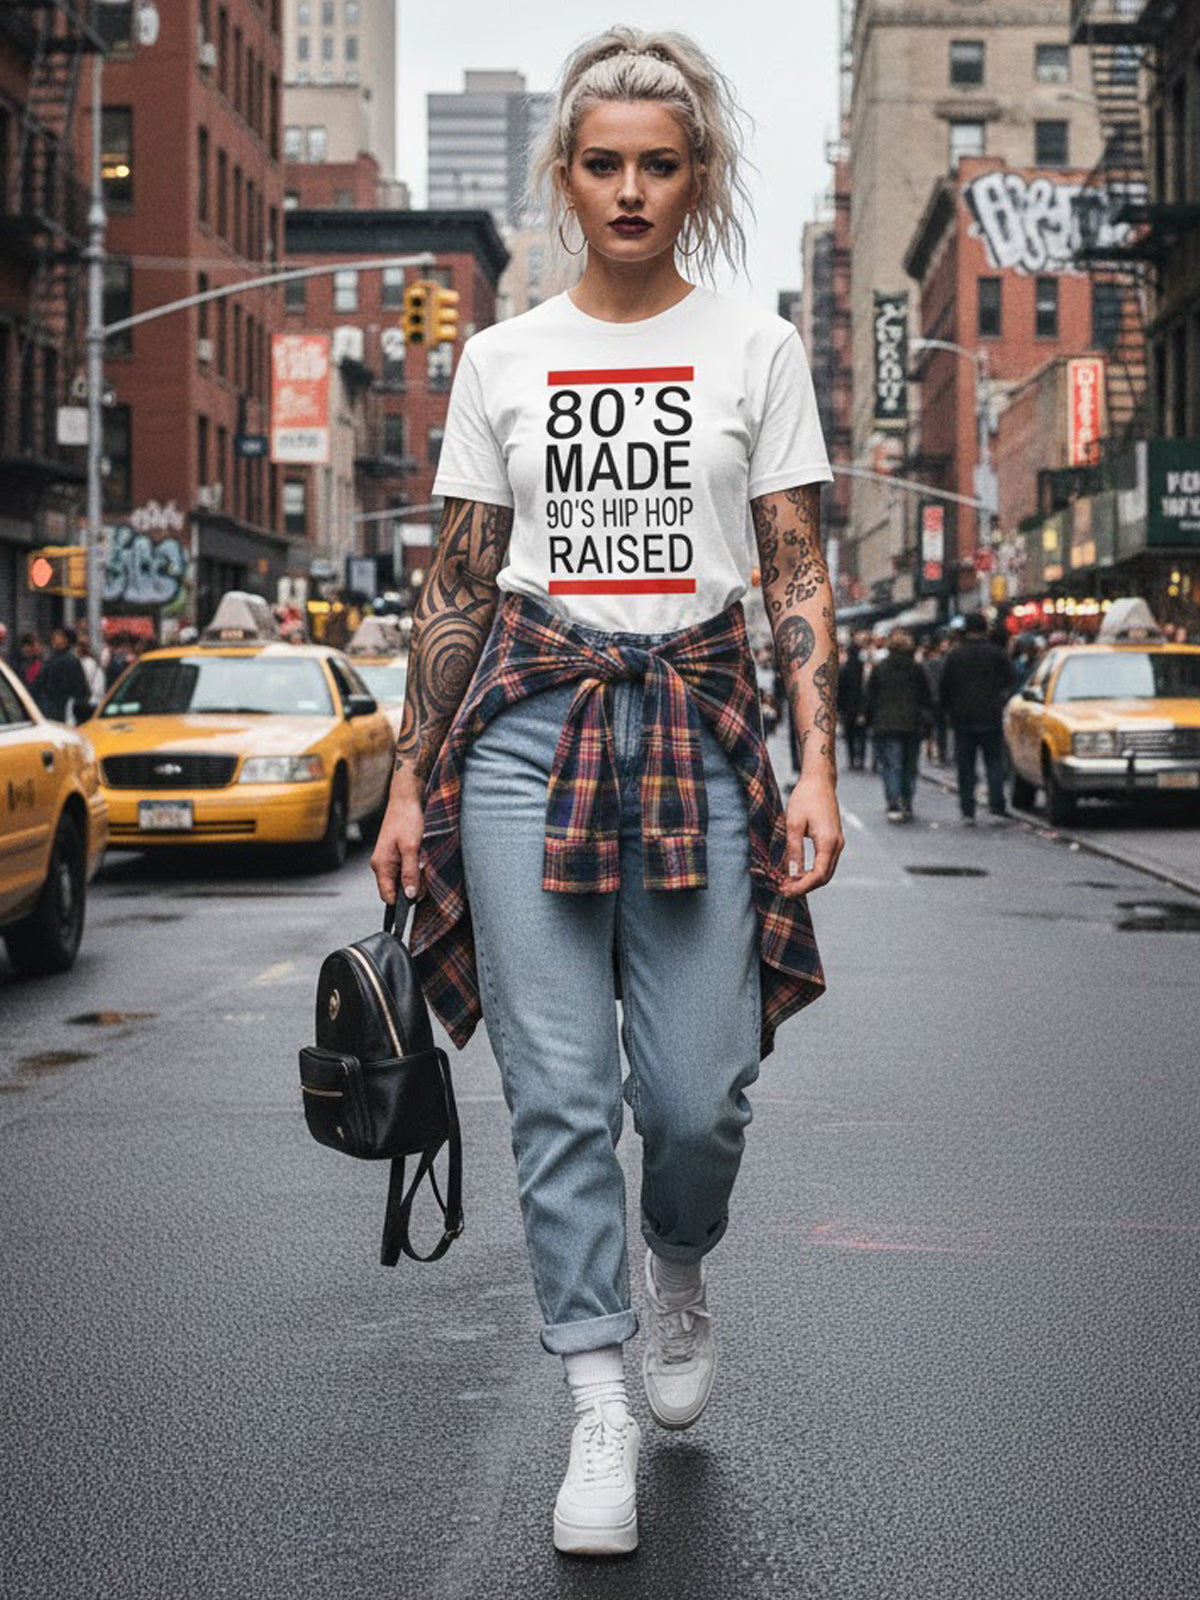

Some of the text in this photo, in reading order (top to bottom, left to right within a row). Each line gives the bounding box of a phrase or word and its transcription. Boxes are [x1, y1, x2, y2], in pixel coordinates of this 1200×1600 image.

[546, 386, 693, 440] 80'S
[545, 440, 692, 493] MADE
[546, 496, 694, 529] 90'S HIP HOP
[549, 533, 693, 574] RAISED
